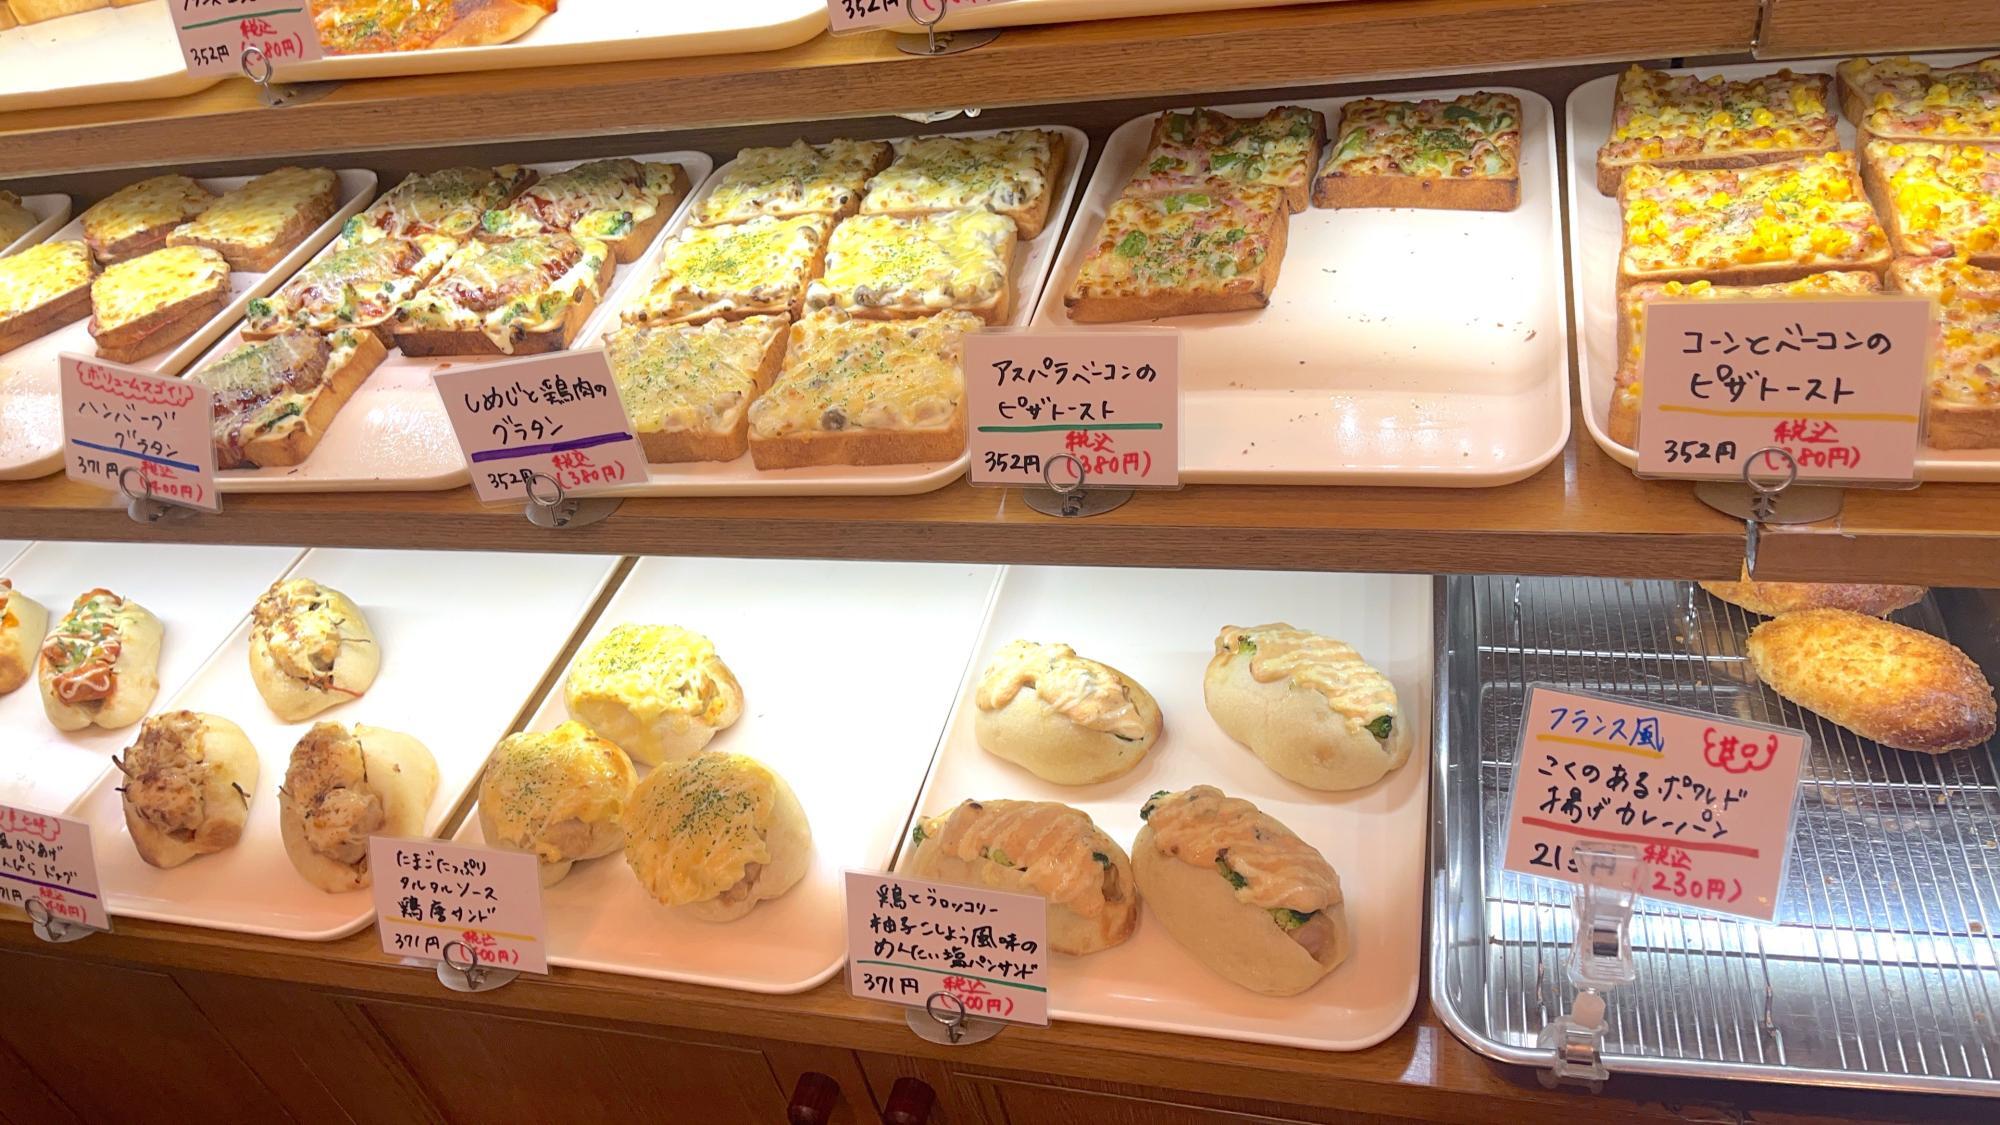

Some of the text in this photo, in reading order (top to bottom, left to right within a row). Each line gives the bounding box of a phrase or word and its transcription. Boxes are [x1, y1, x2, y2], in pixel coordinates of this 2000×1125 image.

[240, 19, 278, 39] 税込
[189, 44, 230, 66] 352円
[1682, 323, 1892, 355] コーンとベーコンの
[992, 357, 1157, 386] アスパラベーコンの
[1690, 364, 1855, 404] ピザトースト
[464, 374, 608, 413] しめじと鶏肉の
[78, 401, 176, 430] ハンバーグ
[998, 396, 1115, 421] ピザトースト
[492, 415, 564, 445] グラタン
[1065, 429, 1114, 453] 税込
[1774, 419, 1840, 443] 税込
[114, 429, 179, 458] グラタン
[1664, 440, 1737, 464] 352円
[77, 456, 119, 479] 371円
[139, 461, 179, 480] 税込
[551, 449, 595, 470] 税込
[984, 451, 1152, 478] 352円 (380円)
[487, 461, 625, 490] 352円 (380円)
[1549, 707, 1665, 753] フランス風
[1718, 736, 1759, 761] 甘口
[1540, 786, 1728, 839] 揚げカレーパン
[1643, 844, 1693, 871] 税込
[400, 877, 499, 900] タルタルソース
[397, 896, 497, 923] 鶏唐サンド
[395, 933, 440, 953] 371円
[462, 930, 497, 947] 税込
[864, 973, 919, 995] 371円
[943, 976, 992, 995] 税込
